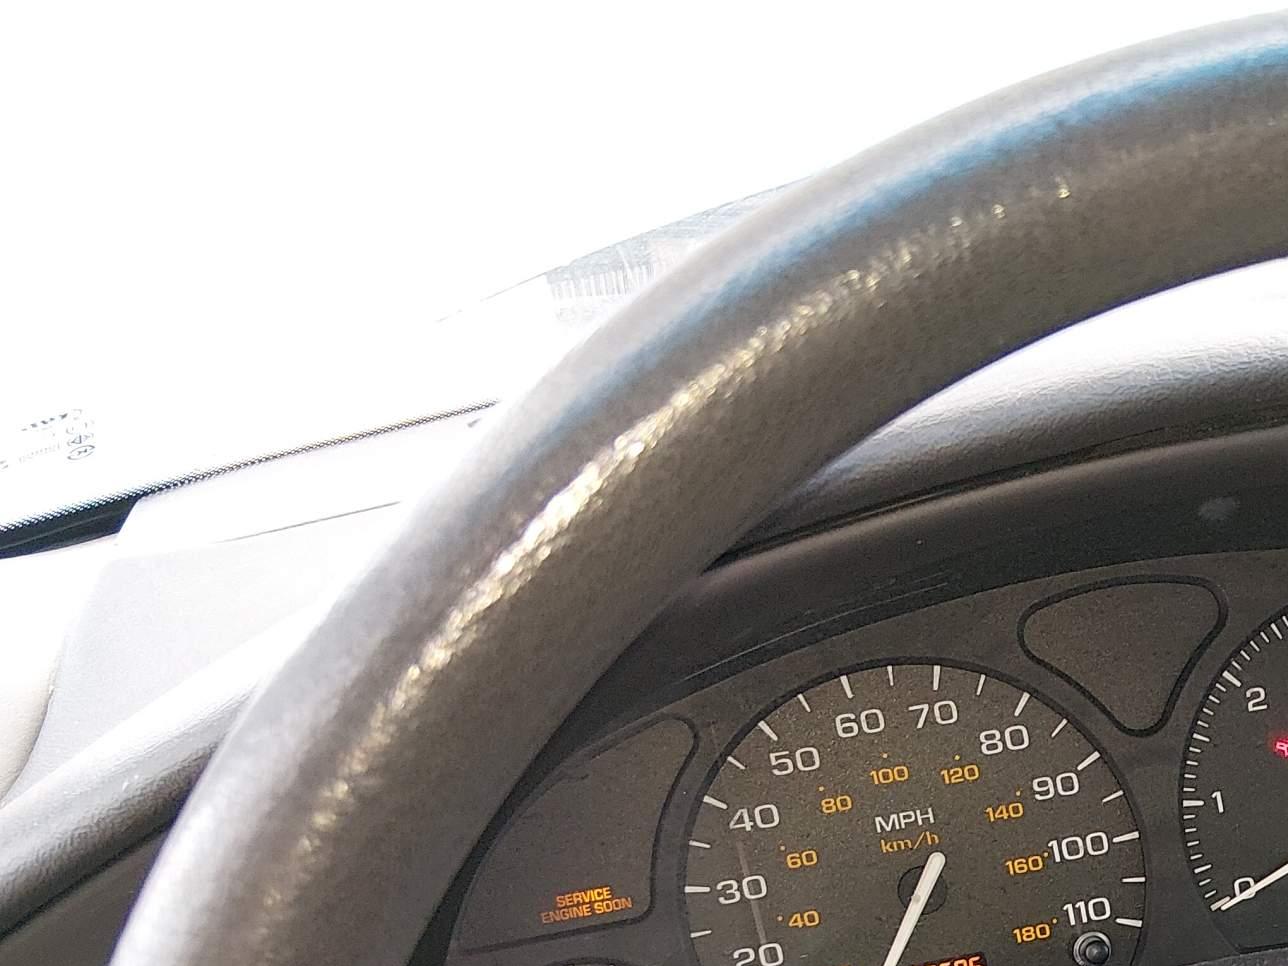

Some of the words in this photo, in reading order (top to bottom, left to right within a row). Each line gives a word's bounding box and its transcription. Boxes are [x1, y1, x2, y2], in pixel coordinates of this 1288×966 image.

[1245, 687, 1269, 712] 2
[835, 708, 884, 738] 60
[908, 700, 958, 729] 70
[979, 725, 1028, 756] 80
[770, 748, 820, 776] 50
[870, 764, 908, 785] 100
[940, 763, 979, 785] 120
[1033, 772, 1080, 801] 90
[821, 794, 852, 814] 80
[985, 801, 1023, 823] 140
[1210, 791, 1225, 814] 1
[729, 803, 780, 832] 40
[875, 807, 934, 834] MPH
[881, 831, 938, 854] km/h
[1048, 831, 1108, 863] 100
[785, 849, 817, 869] 60
[1005, 855, 1043, 875] 160
[556, 886, 612, 908] SERVICE
[717, 874, 766, 904] 30
[541, 904, 592, 924] ENGINE
[594, 897, 633, 914] SOON
[788, 909, 820, 928] 40
[1063, 897, 1110, 926] 110
[1012, 922, 1050, 943] 180
